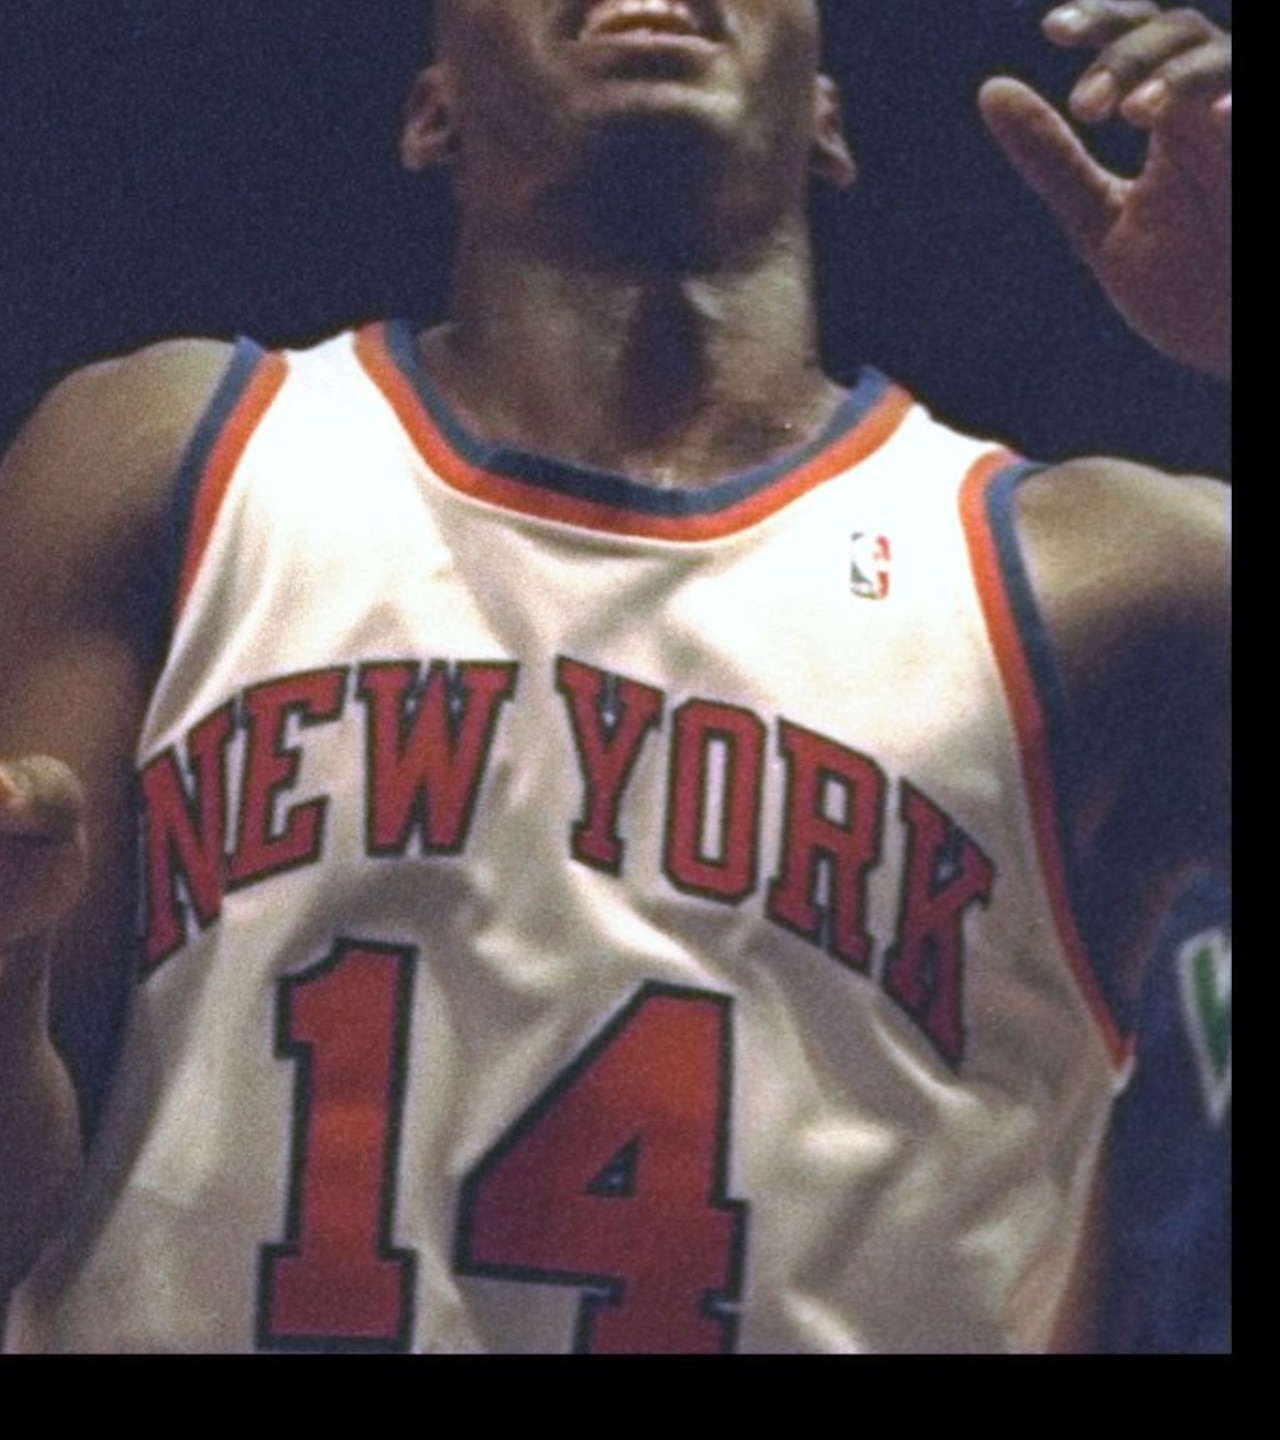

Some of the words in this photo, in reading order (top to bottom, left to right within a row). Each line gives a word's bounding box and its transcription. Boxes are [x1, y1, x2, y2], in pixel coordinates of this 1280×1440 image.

[136, 659, 519, 974] NEW
[555, 655, 995, 1077] YORK
[255, 936, 750, 1354] 14
